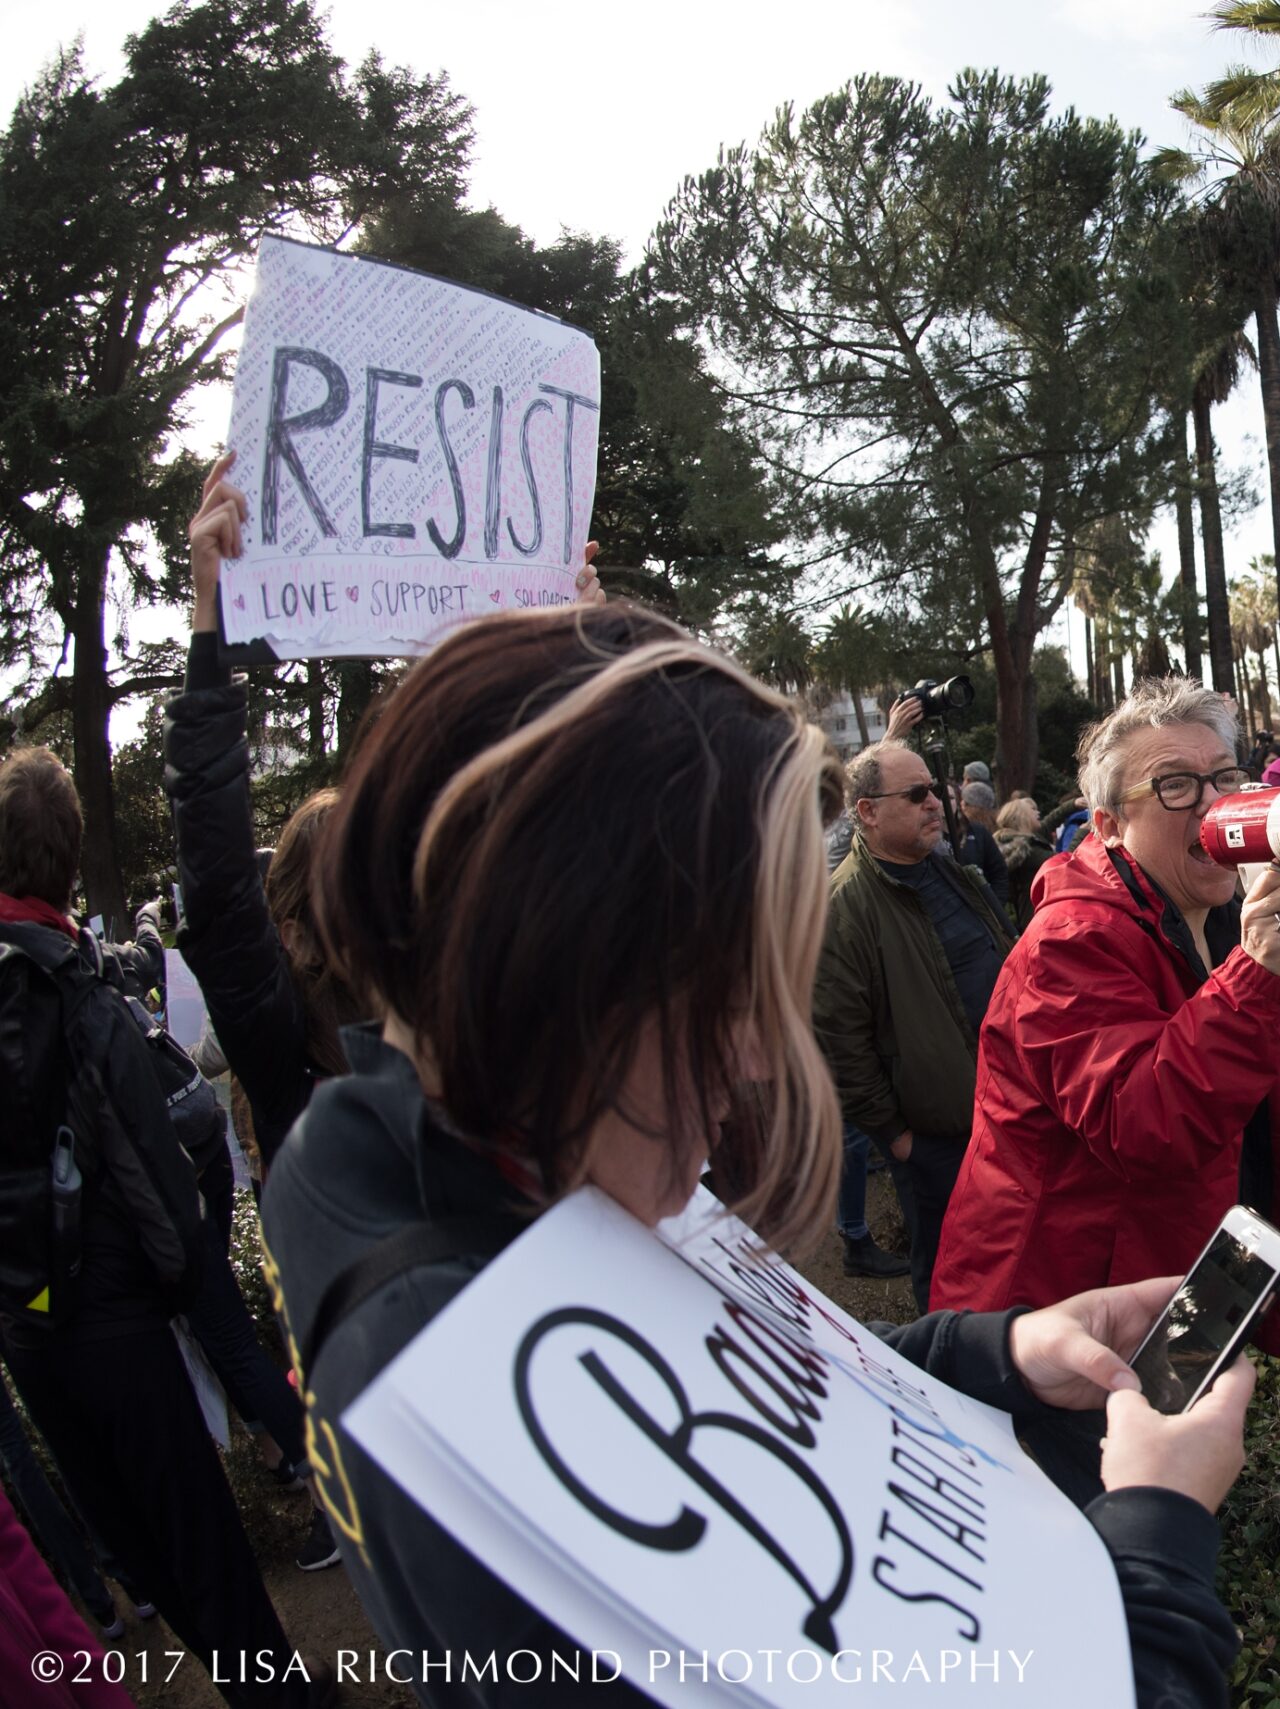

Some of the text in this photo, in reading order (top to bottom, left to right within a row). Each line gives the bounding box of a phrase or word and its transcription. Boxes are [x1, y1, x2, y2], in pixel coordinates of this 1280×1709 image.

[261, 346, 600, 566] RESIST
[261, 580, 339, 620] LOVE
[371, 579, 470, 616] SUPPORT
